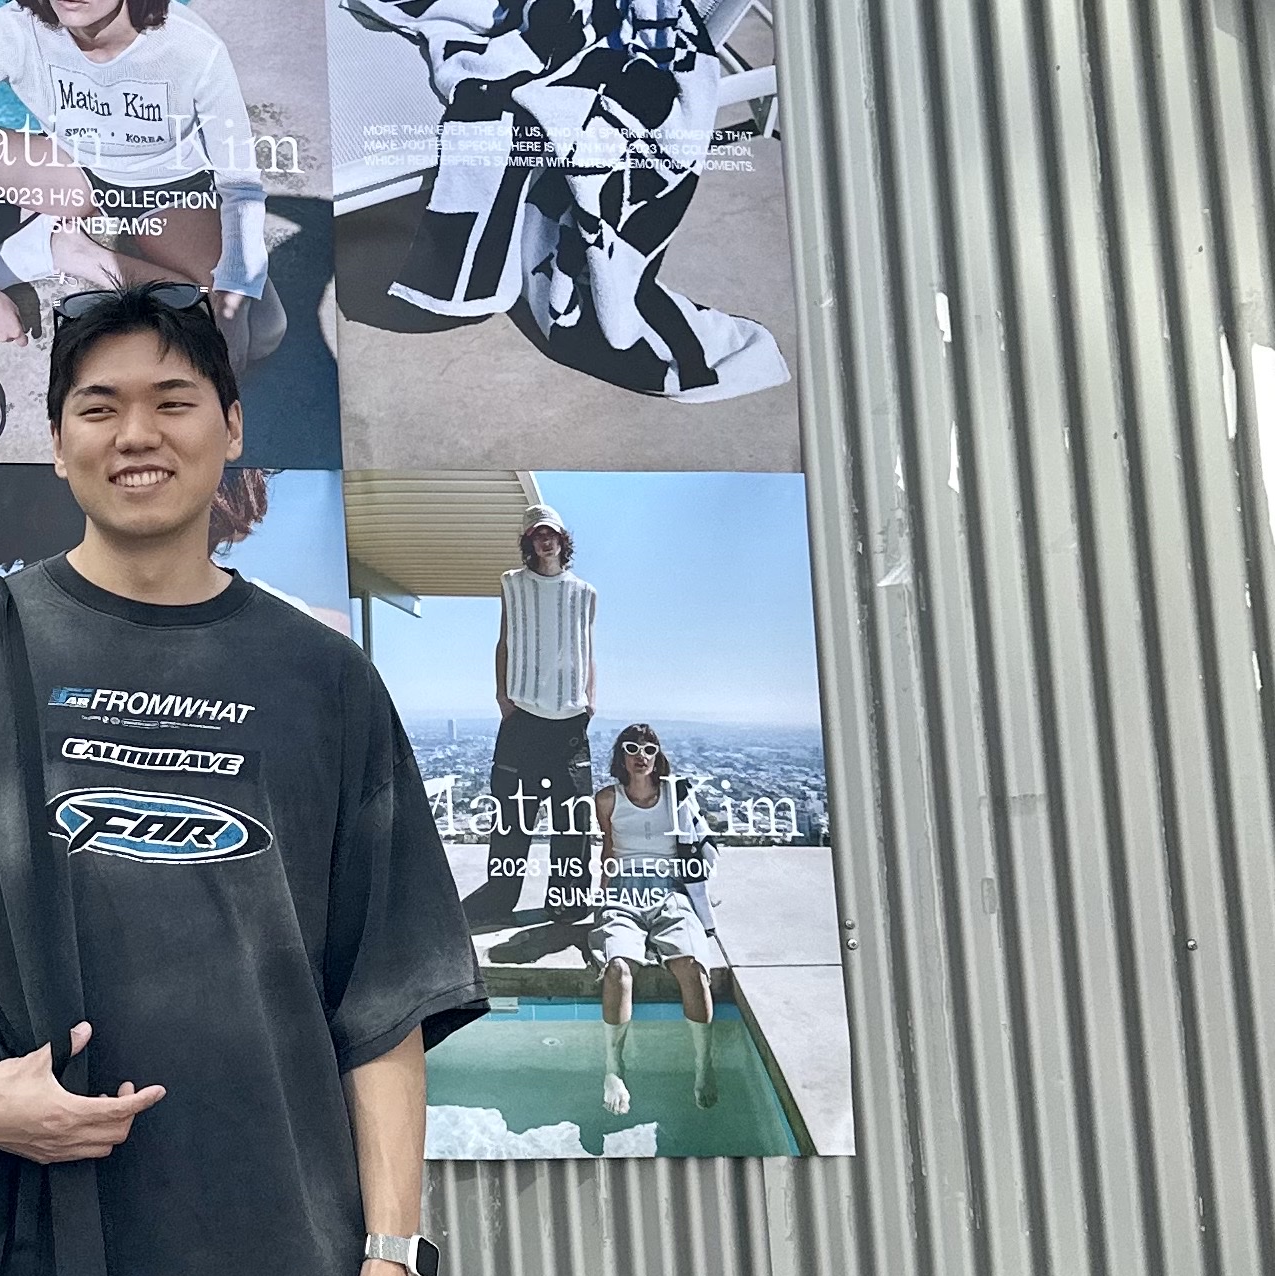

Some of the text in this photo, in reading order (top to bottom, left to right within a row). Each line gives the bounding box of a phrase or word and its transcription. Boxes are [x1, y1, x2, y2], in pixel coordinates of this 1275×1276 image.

[58, 79, 163, 122] Matin Kim
[125, 132, 165, 144] KOREA
[167, 114, 306, 174] Kim
[525, 126, 544, 138] US,
[725, 130, 753, 141] THAT
[511, 141, 542, 152] HERE
[544, 142, 555, 152] IS
[546, 156, 575, 168] WITH
[49, 187, 85, 206] H/S
[90, 188, 218, 210] COLLECTION
[90, 688, 256, 724] FROMWHAT
[660, 774, 804, 837] Kim
[489, 857, 719, 878] 2023 H/S COLLECTION
